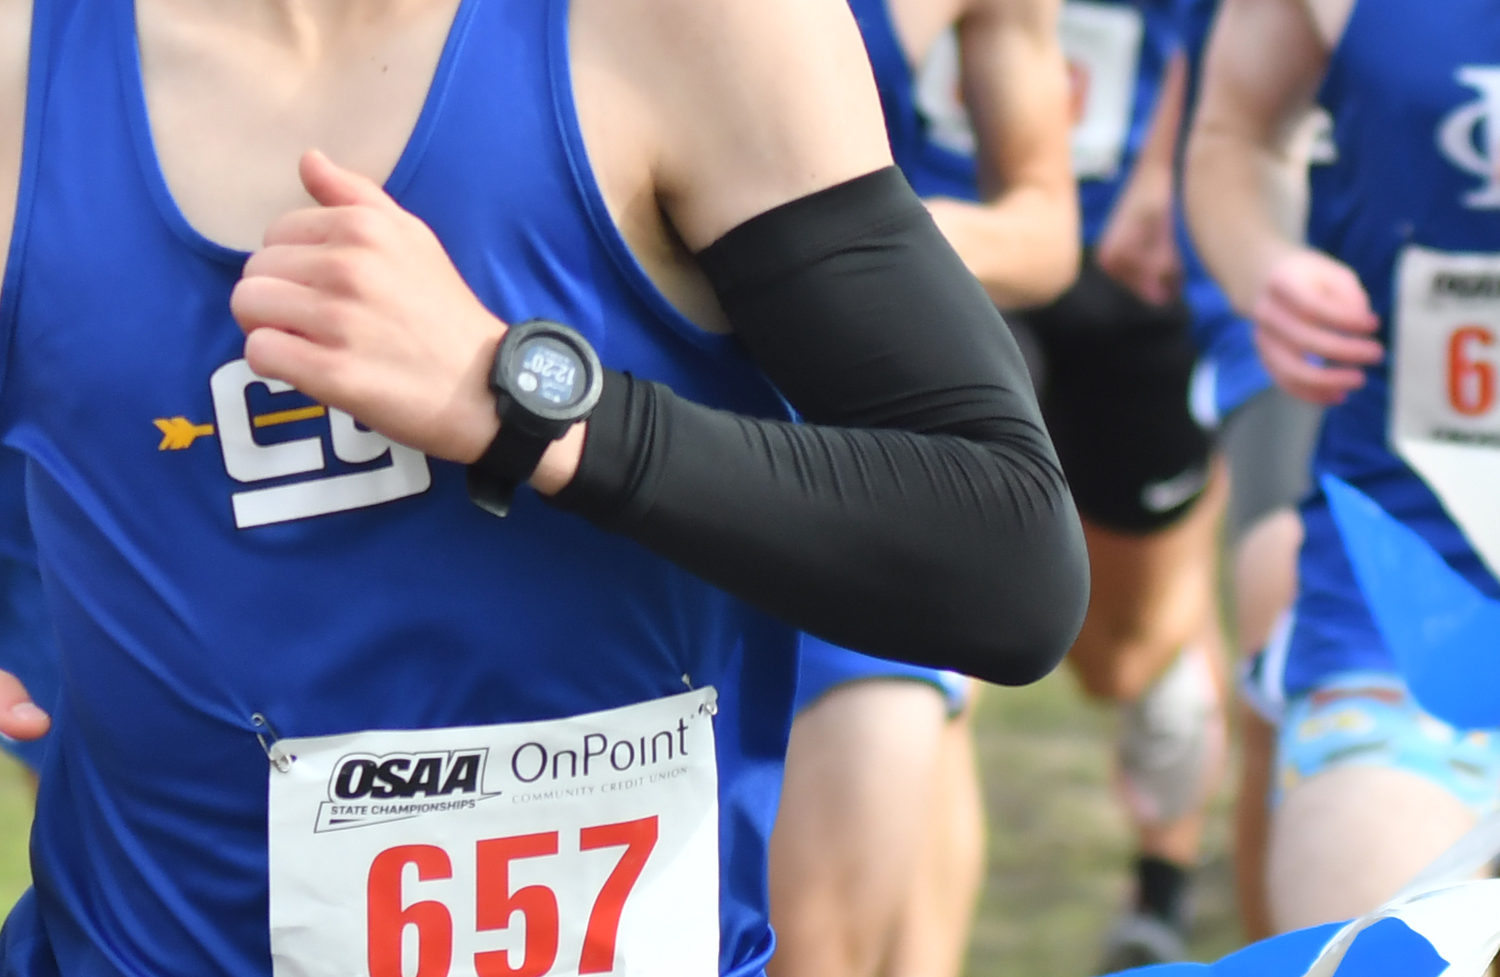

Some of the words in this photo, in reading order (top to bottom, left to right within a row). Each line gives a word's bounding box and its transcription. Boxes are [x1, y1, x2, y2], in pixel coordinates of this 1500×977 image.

[511, 717, 689, 783] OnPoint
[335, 755, 481, 800] OSAA
[511, 785, 596, 805] COMMUNITY
[600, 776, 645, 793] CREDIT
[649, 766, 689, 784] UNION
[330, 804, 368, 816] STATE
[371, 798, 477, 816] CHAMPIONSHIPS
[367, 814, 659, 977] 657
